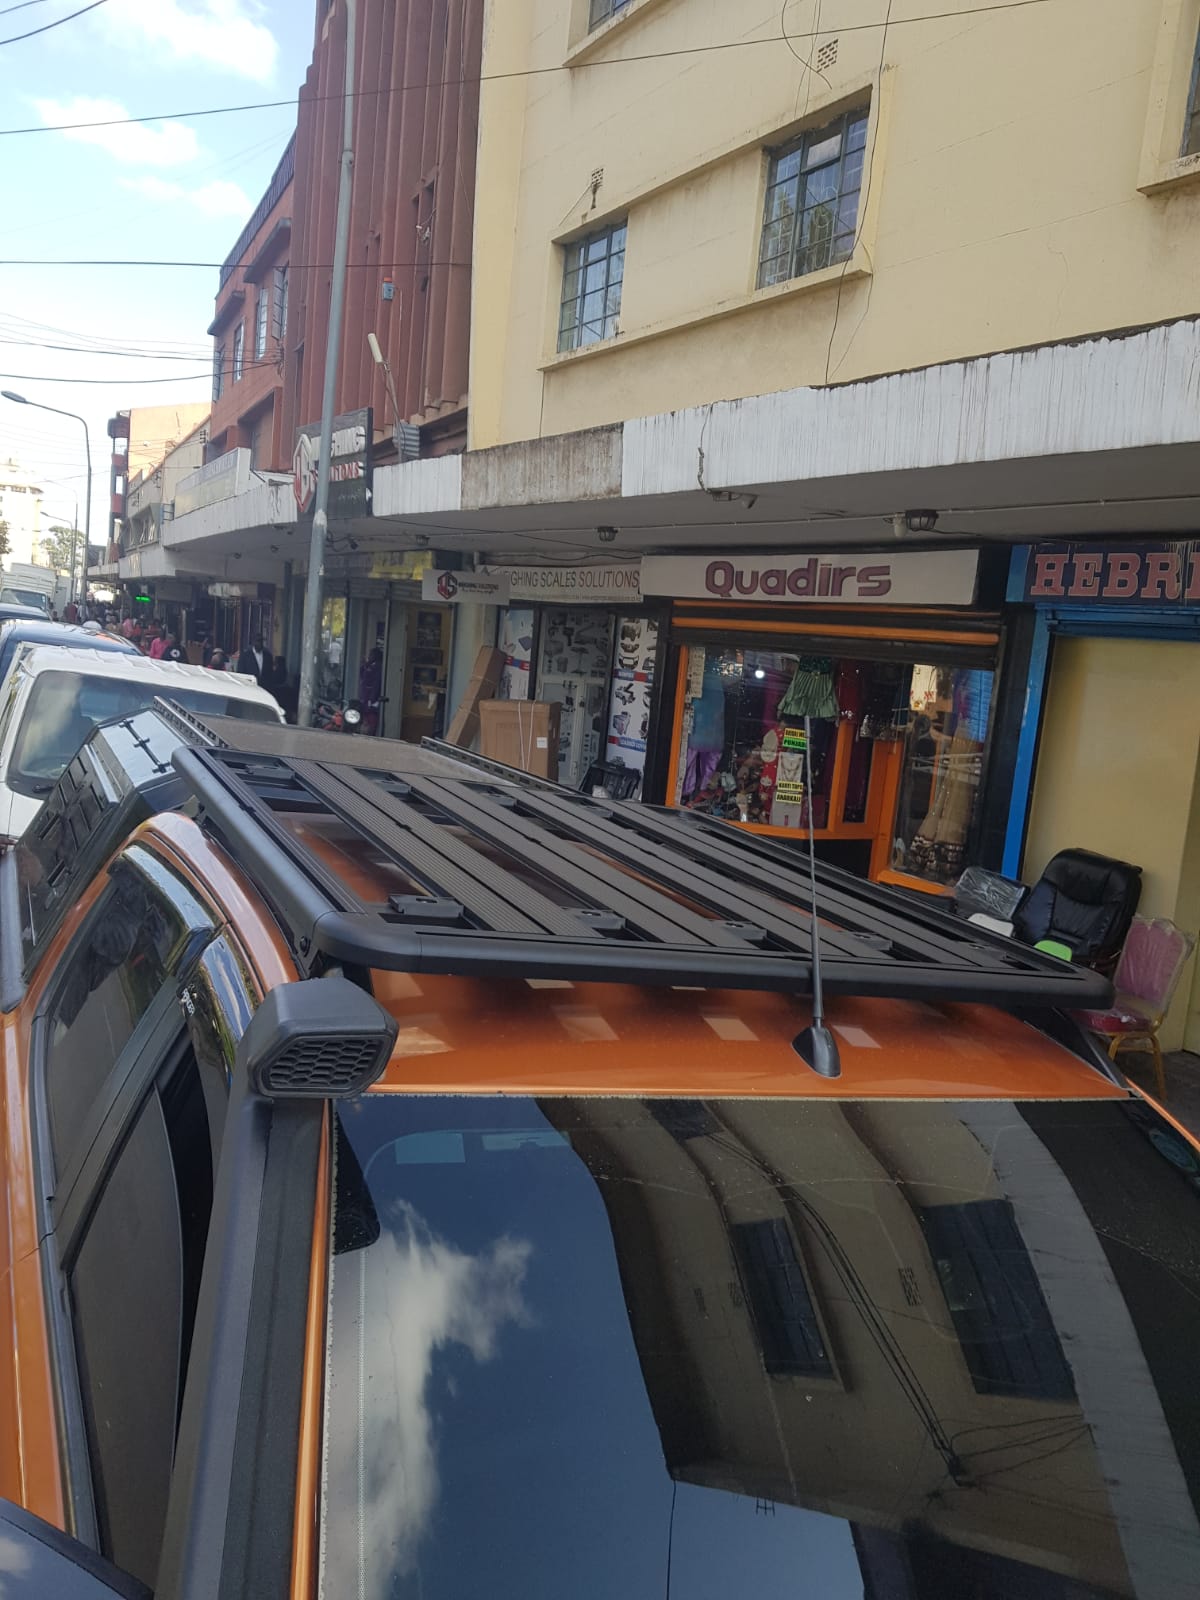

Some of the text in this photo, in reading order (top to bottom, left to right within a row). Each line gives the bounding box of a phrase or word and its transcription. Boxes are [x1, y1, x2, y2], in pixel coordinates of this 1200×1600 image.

[541, 570, 577, 588] SCALES
[579, 570, 640, 588] SOLUTIONS
[705, 558, 892, 597] Quadirs
